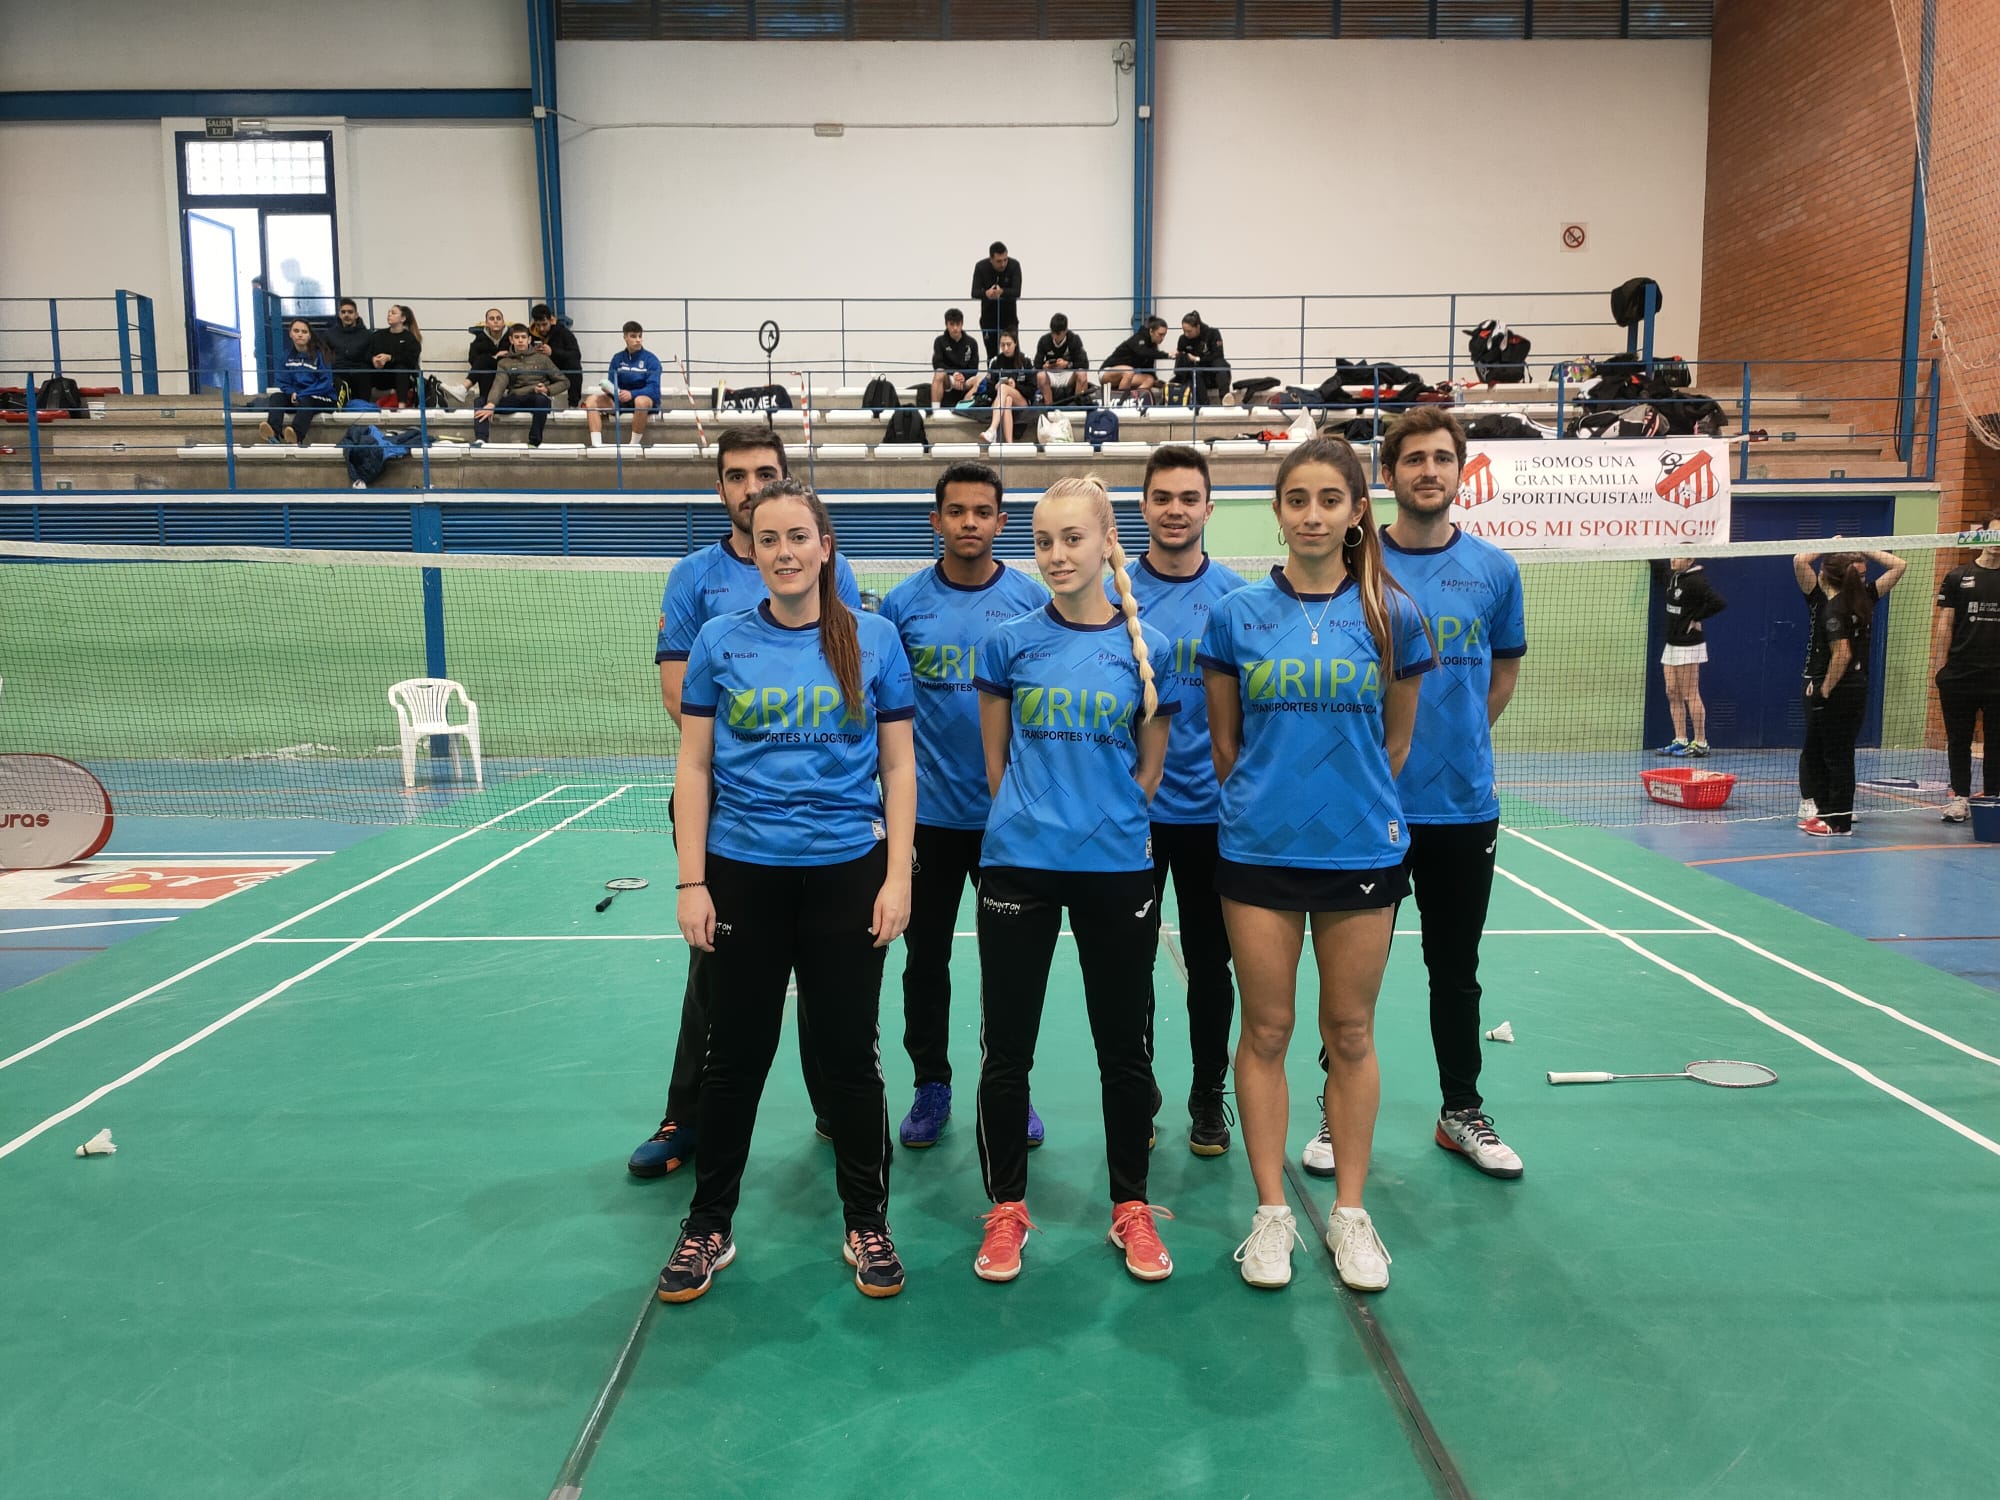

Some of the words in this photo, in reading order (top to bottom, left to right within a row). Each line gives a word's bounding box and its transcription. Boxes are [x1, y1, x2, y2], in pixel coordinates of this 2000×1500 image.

[207, 119, 232, 127] SALIDA
[212, 127, 227, 135] EXIT
[1532, 455, 1593, 469] SOMOS
[1599, 455, 1636, 468] UNA
[1514, 474, 1564, 487] GRAN
[1569, 473, 1639, 486] FAMILIA
[1502, 491, 1653, 505] SPORTINGUISTA!!!
[1456, 519, 1537, 537] VAMOS
[1544, 520, 1572, 537] MI
[1579, 519, 1717, 537] SPORTING!!!
[1426, 615, 1482, 653] PA
[941, 645, 976, 680] RI
[1280, 658, 1381, 700] RIPA
[1048, 687, 1133, 739] RIPA
[1321, 703, 1328, 713] Y
[1331, 703, 1377, 714] LOGISTICA
[804, 732, 811, 743] Y
[1085, 732, 1092, 742] Y
[1094, 733, 1127, 750] LOGCA
